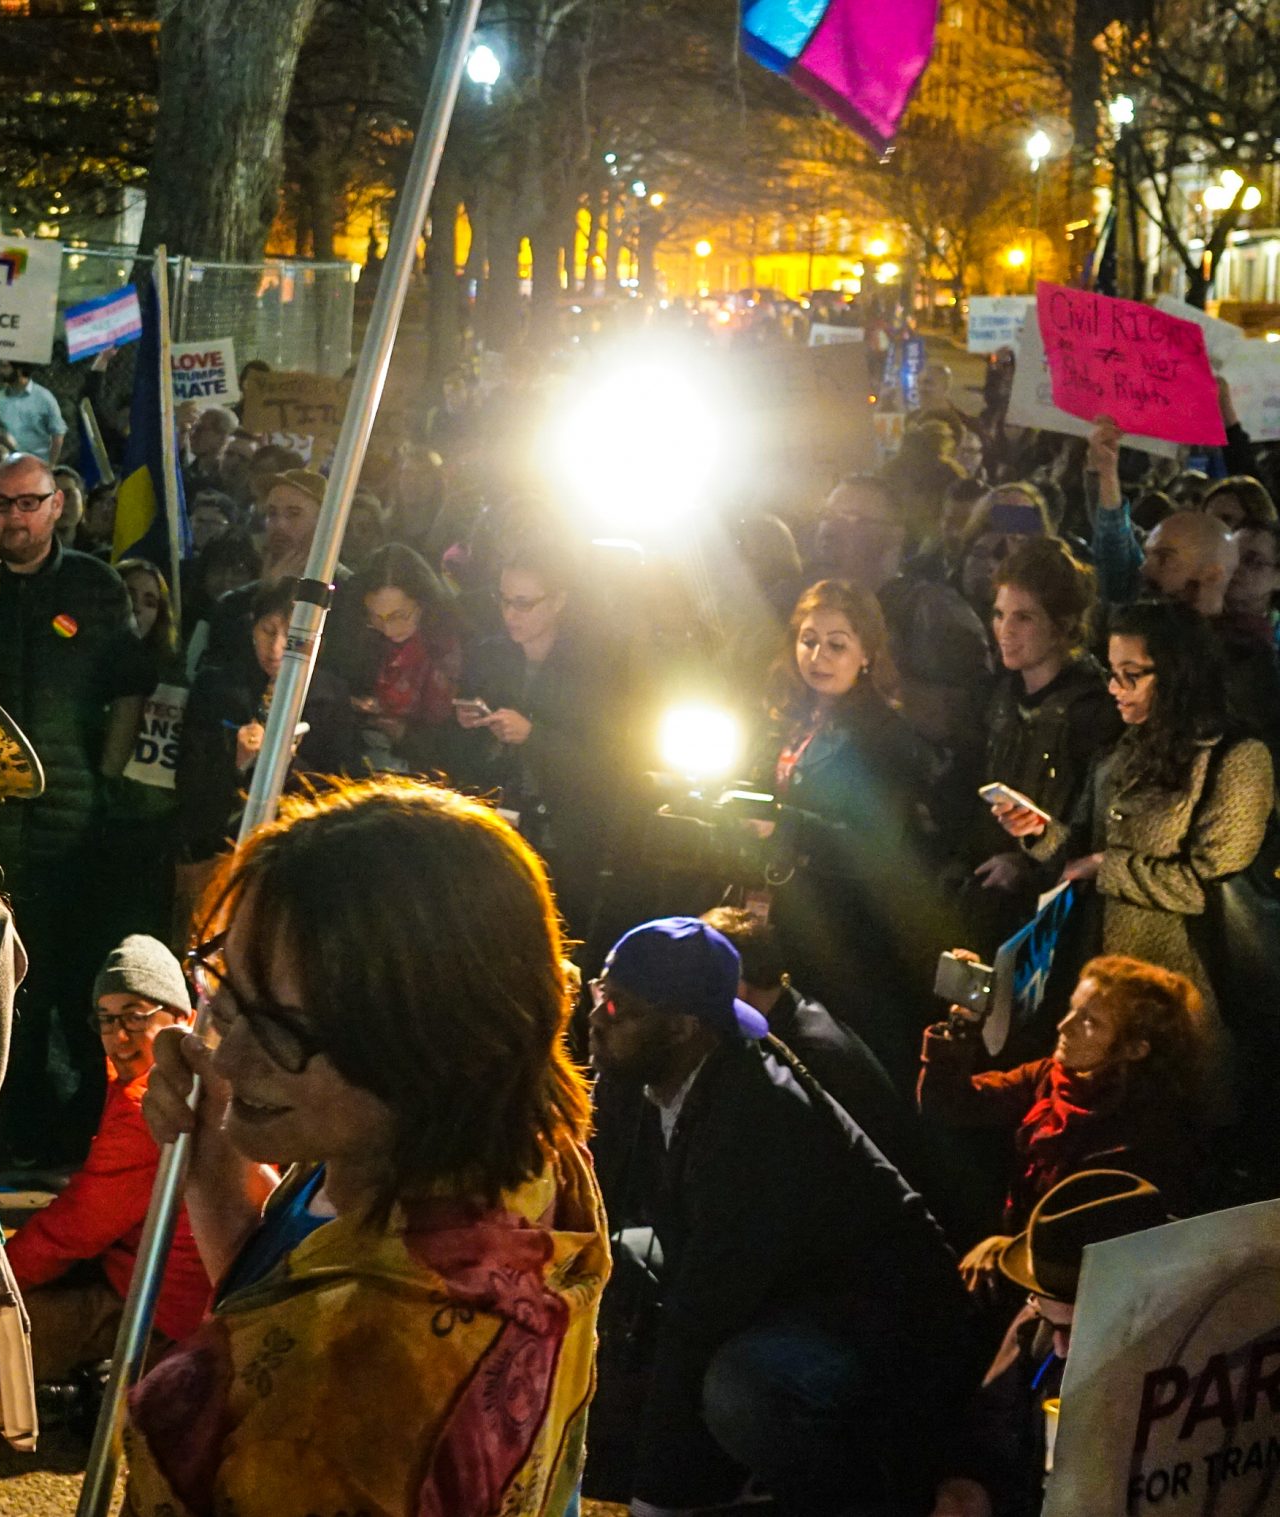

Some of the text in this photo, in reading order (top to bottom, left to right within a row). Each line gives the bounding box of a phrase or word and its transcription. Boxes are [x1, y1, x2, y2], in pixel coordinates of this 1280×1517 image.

[1050, 291, 1098, 336] Civil
[171, 351, 223, 370] LOVE
[1142, 355, 1179, 378] NOT
[172, 368, 226, 382] TRUMPS
[174, 380, 228, 398] HATE
